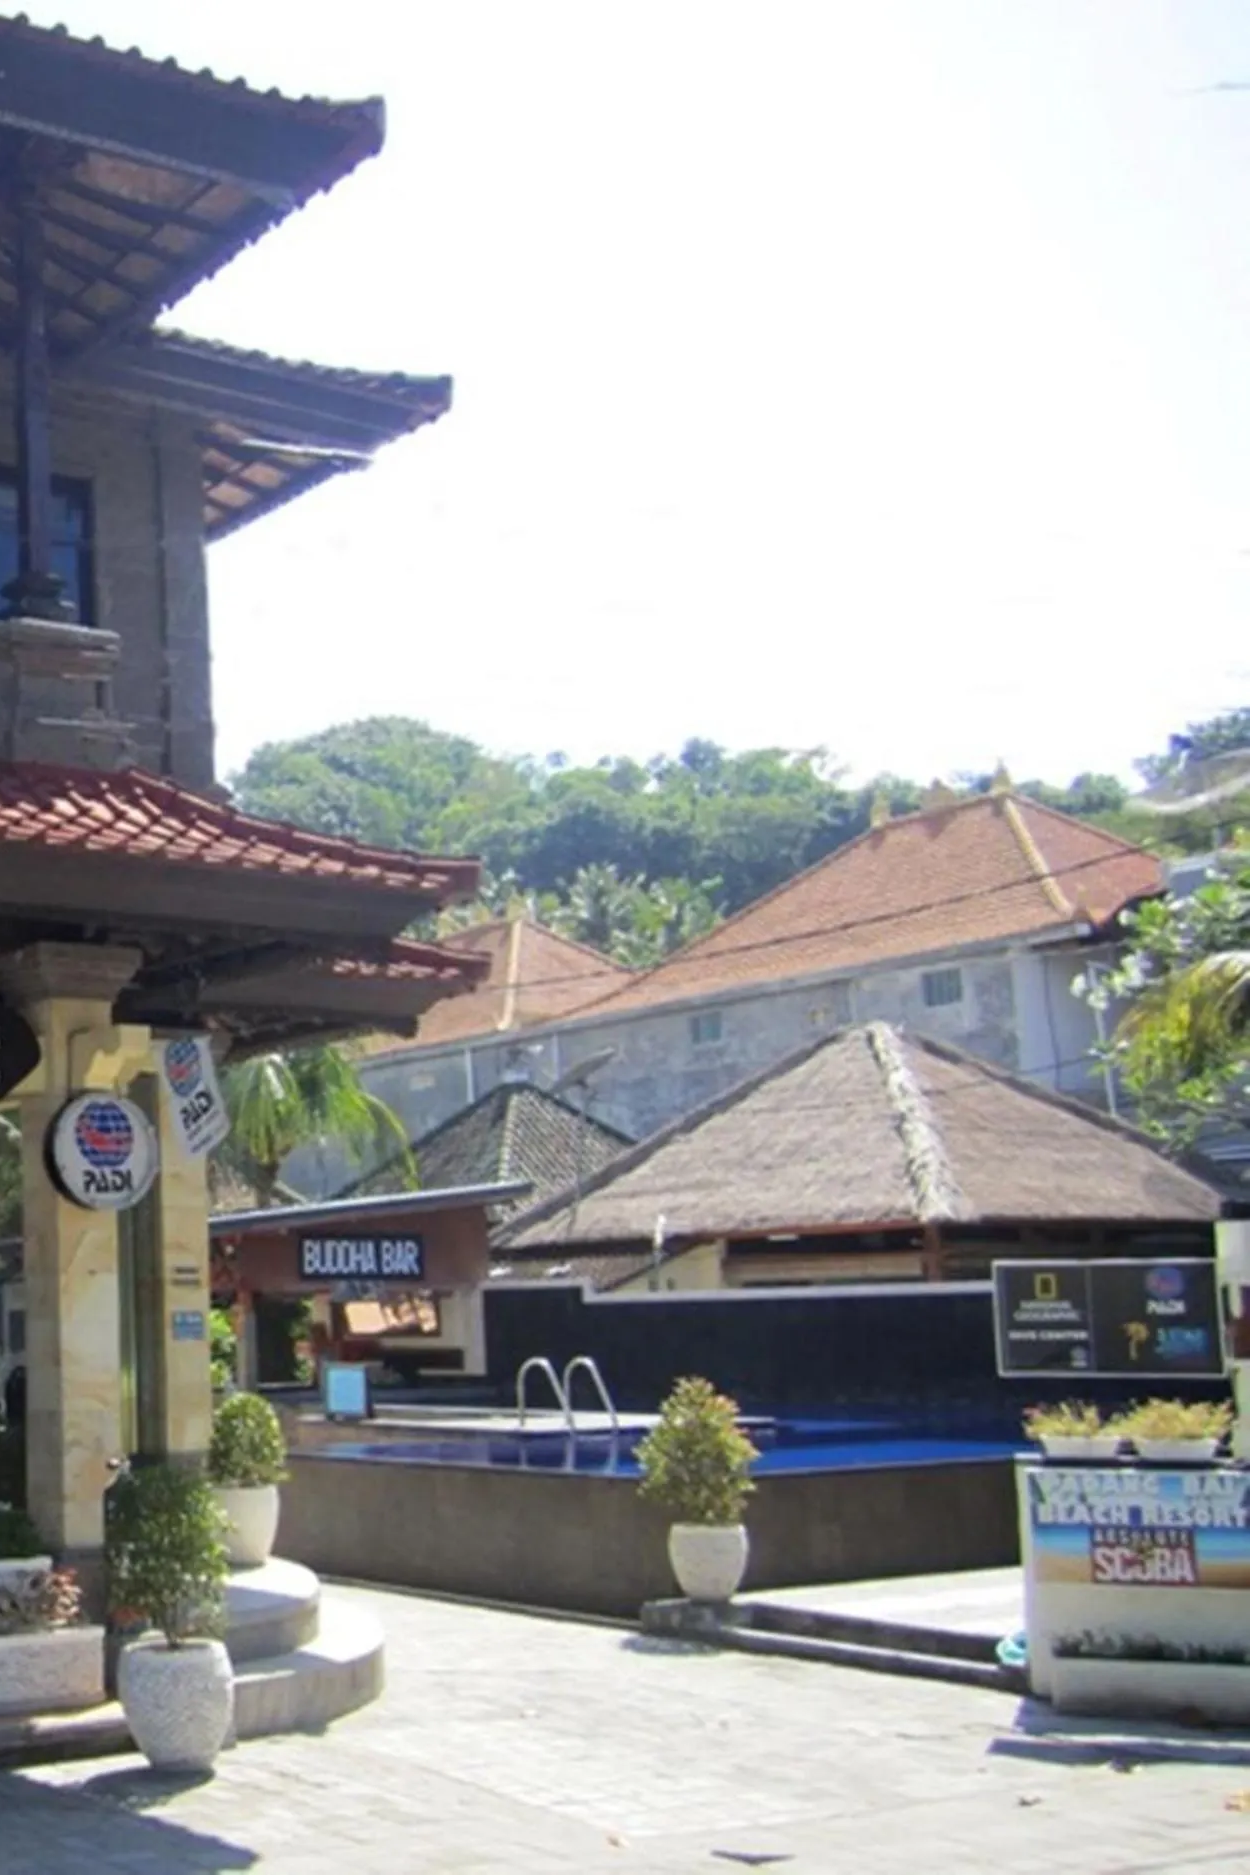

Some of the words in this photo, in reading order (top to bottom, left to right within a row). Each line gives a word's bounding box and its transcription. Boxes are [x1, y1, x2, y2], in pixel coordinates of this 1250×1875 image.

[81, 1168, 133, 1194] PADI
[302, 1238, 379, 1275] BUDDHA
[381, 1239, 421, 1276] BAR
[1041, 1472, 1161, 1498] PADANG
[1181, 1472, 1236, 1498] BAI
[1037, 1499, 1129, 1525] BEACH
[1141, 1503, 1248, 1528] RESORT
[1094, 1545, 1195, 1582] SCUBA
